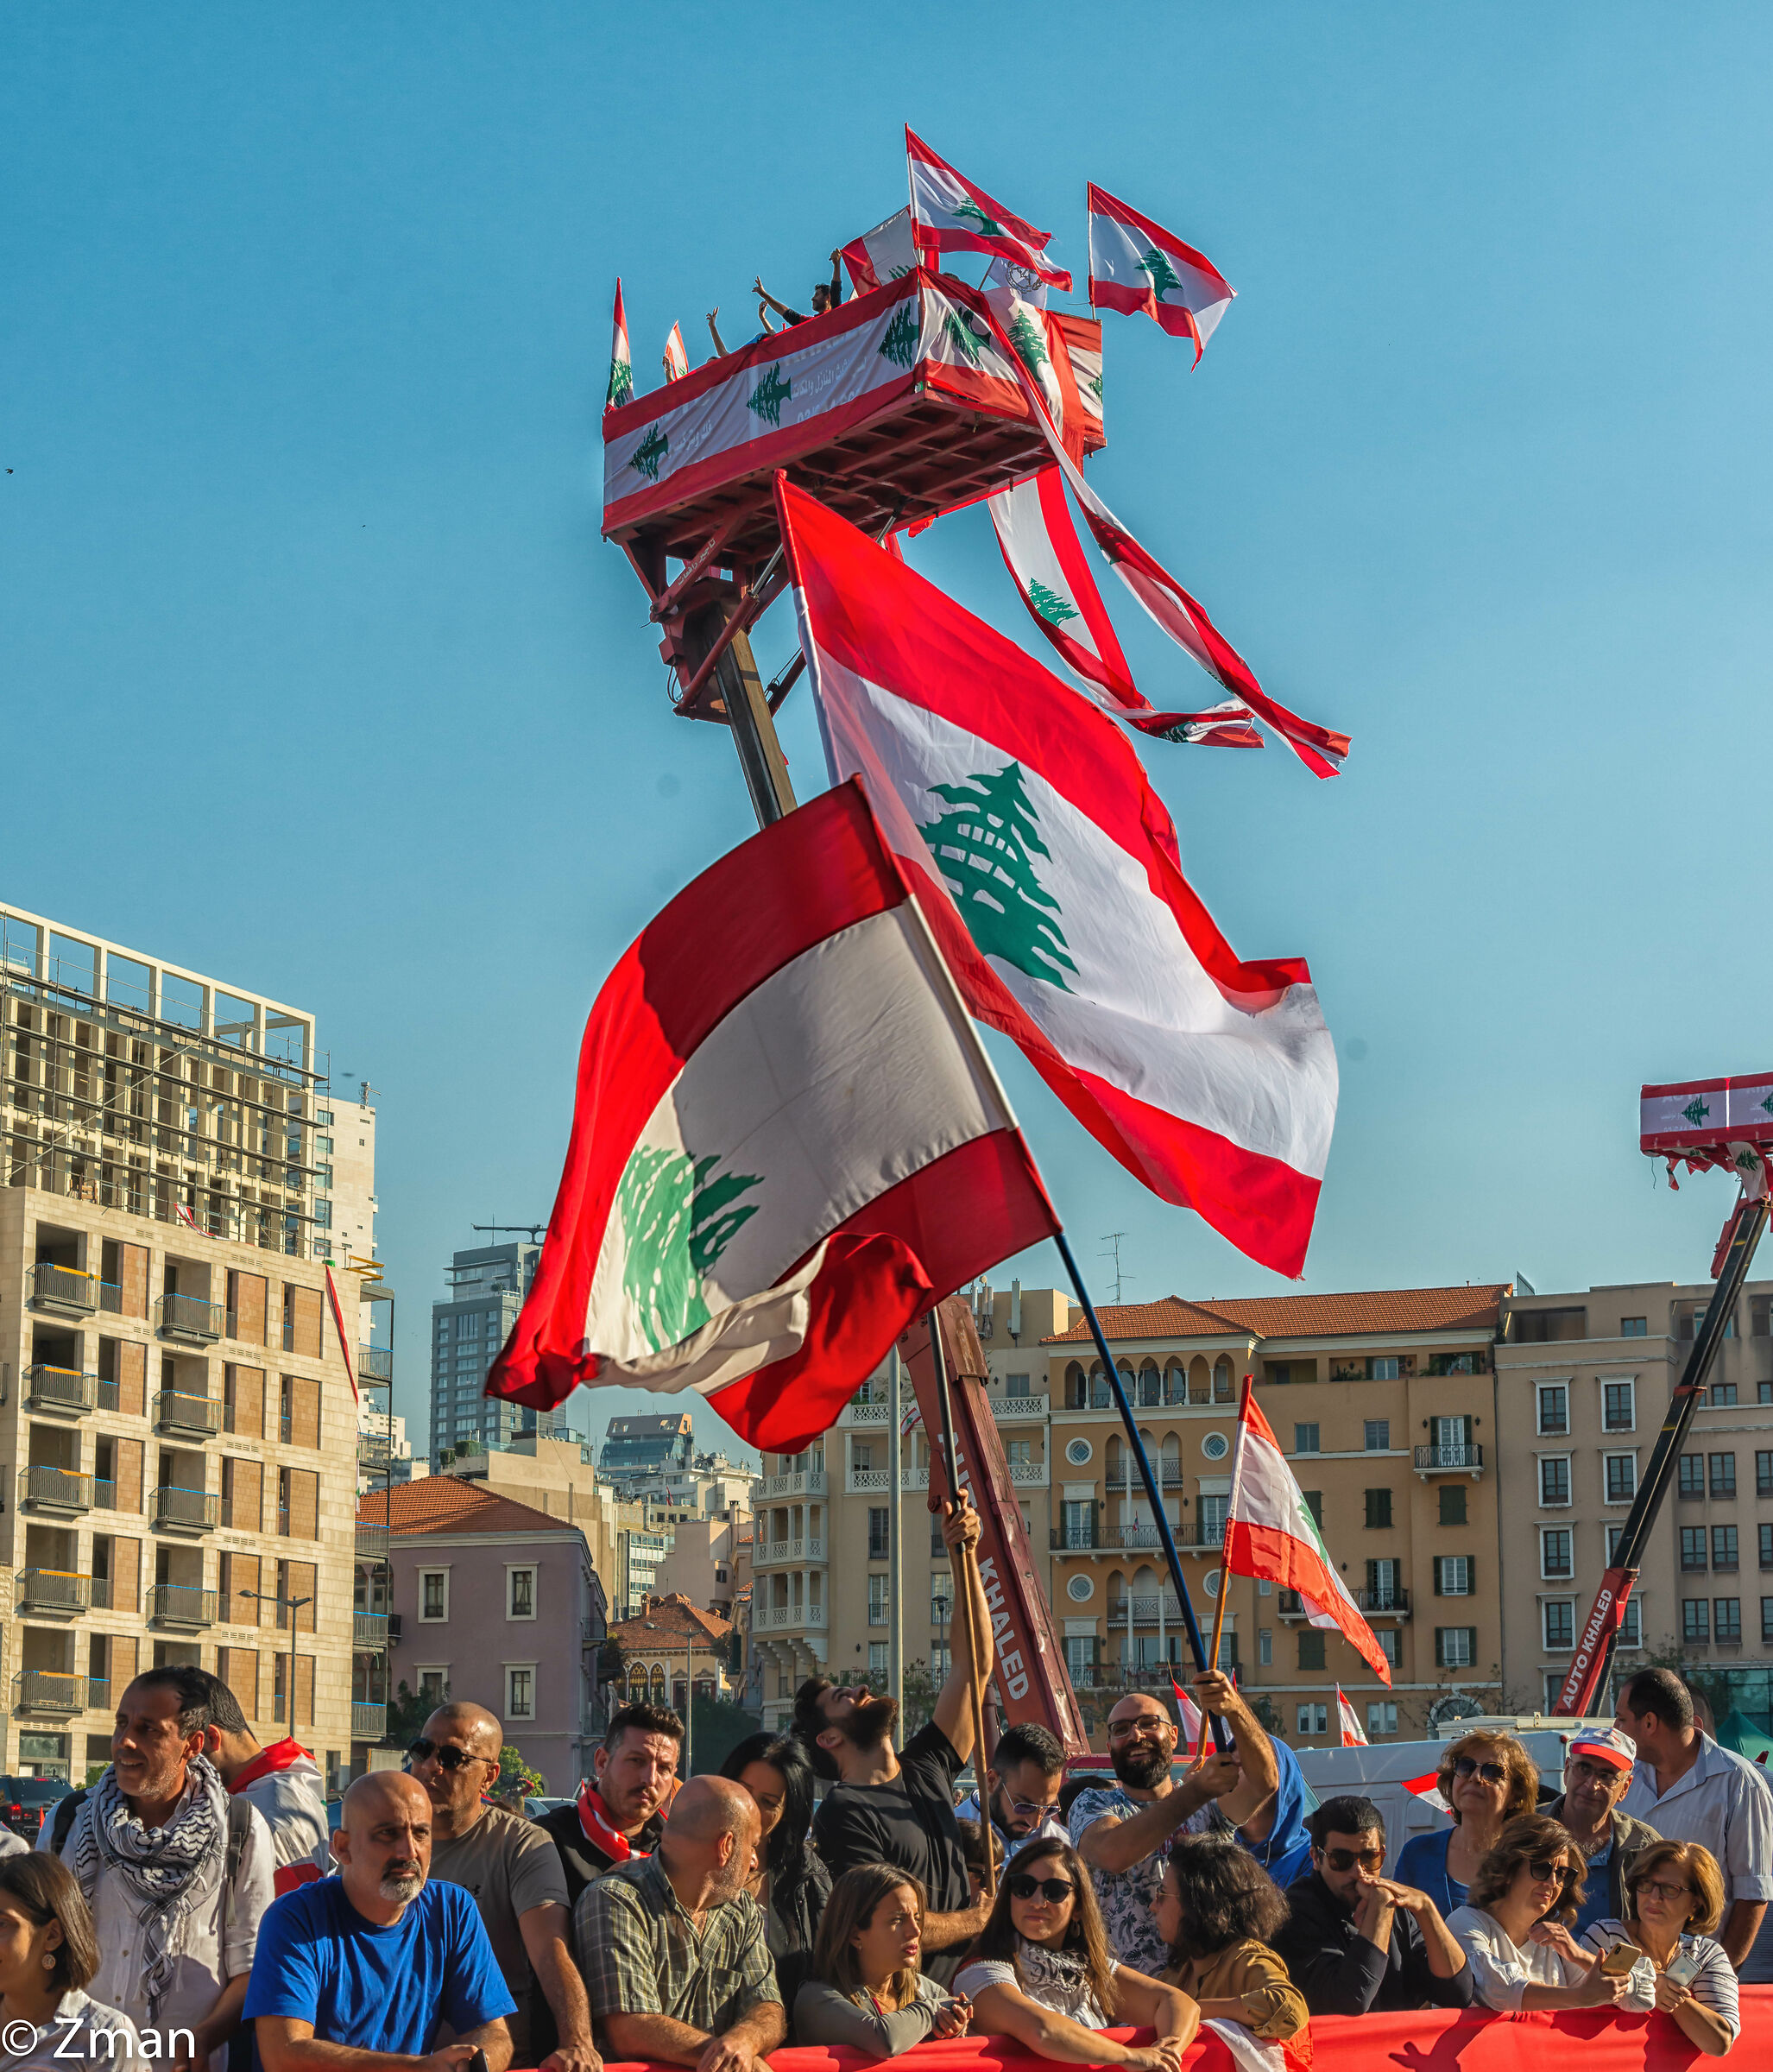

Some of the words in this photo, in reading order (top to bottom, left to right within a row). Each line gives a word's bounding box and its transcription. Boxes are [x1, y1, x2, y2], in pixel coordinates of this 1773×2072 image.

[978, 1557, 1029, 1700] KHALED
[1562, 1653, 1588, 1709] AUTO
[1581, 1589, 1612, 1653] KHALED
